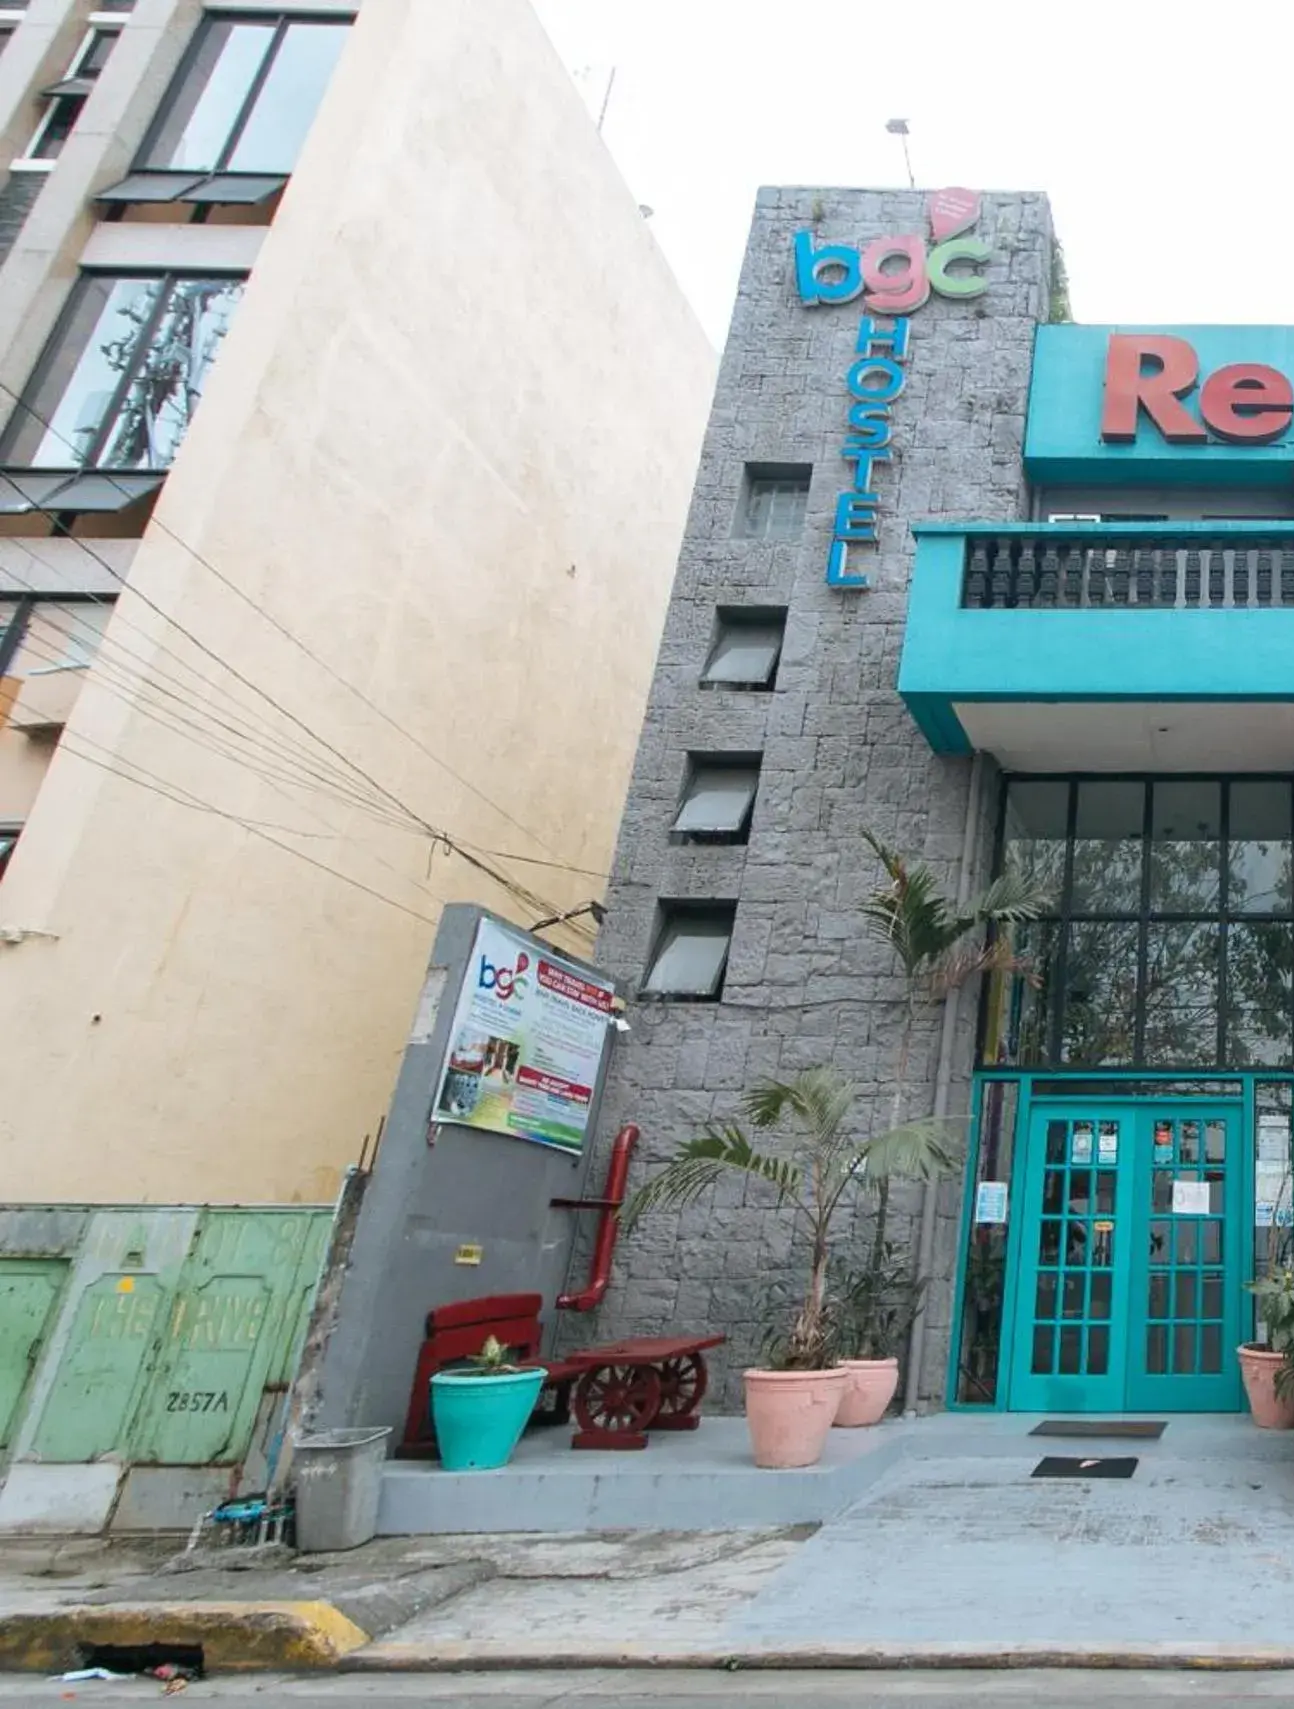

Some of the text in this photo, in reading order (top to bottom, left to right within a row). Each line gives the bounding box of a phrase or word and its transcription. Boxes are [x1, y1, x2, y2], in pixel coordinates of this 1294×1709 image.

[794, 226, 992, 316] bgc
[826, 315, 912, 590] HOSTEL
[166, 1391, 229, 1413] 2857A
